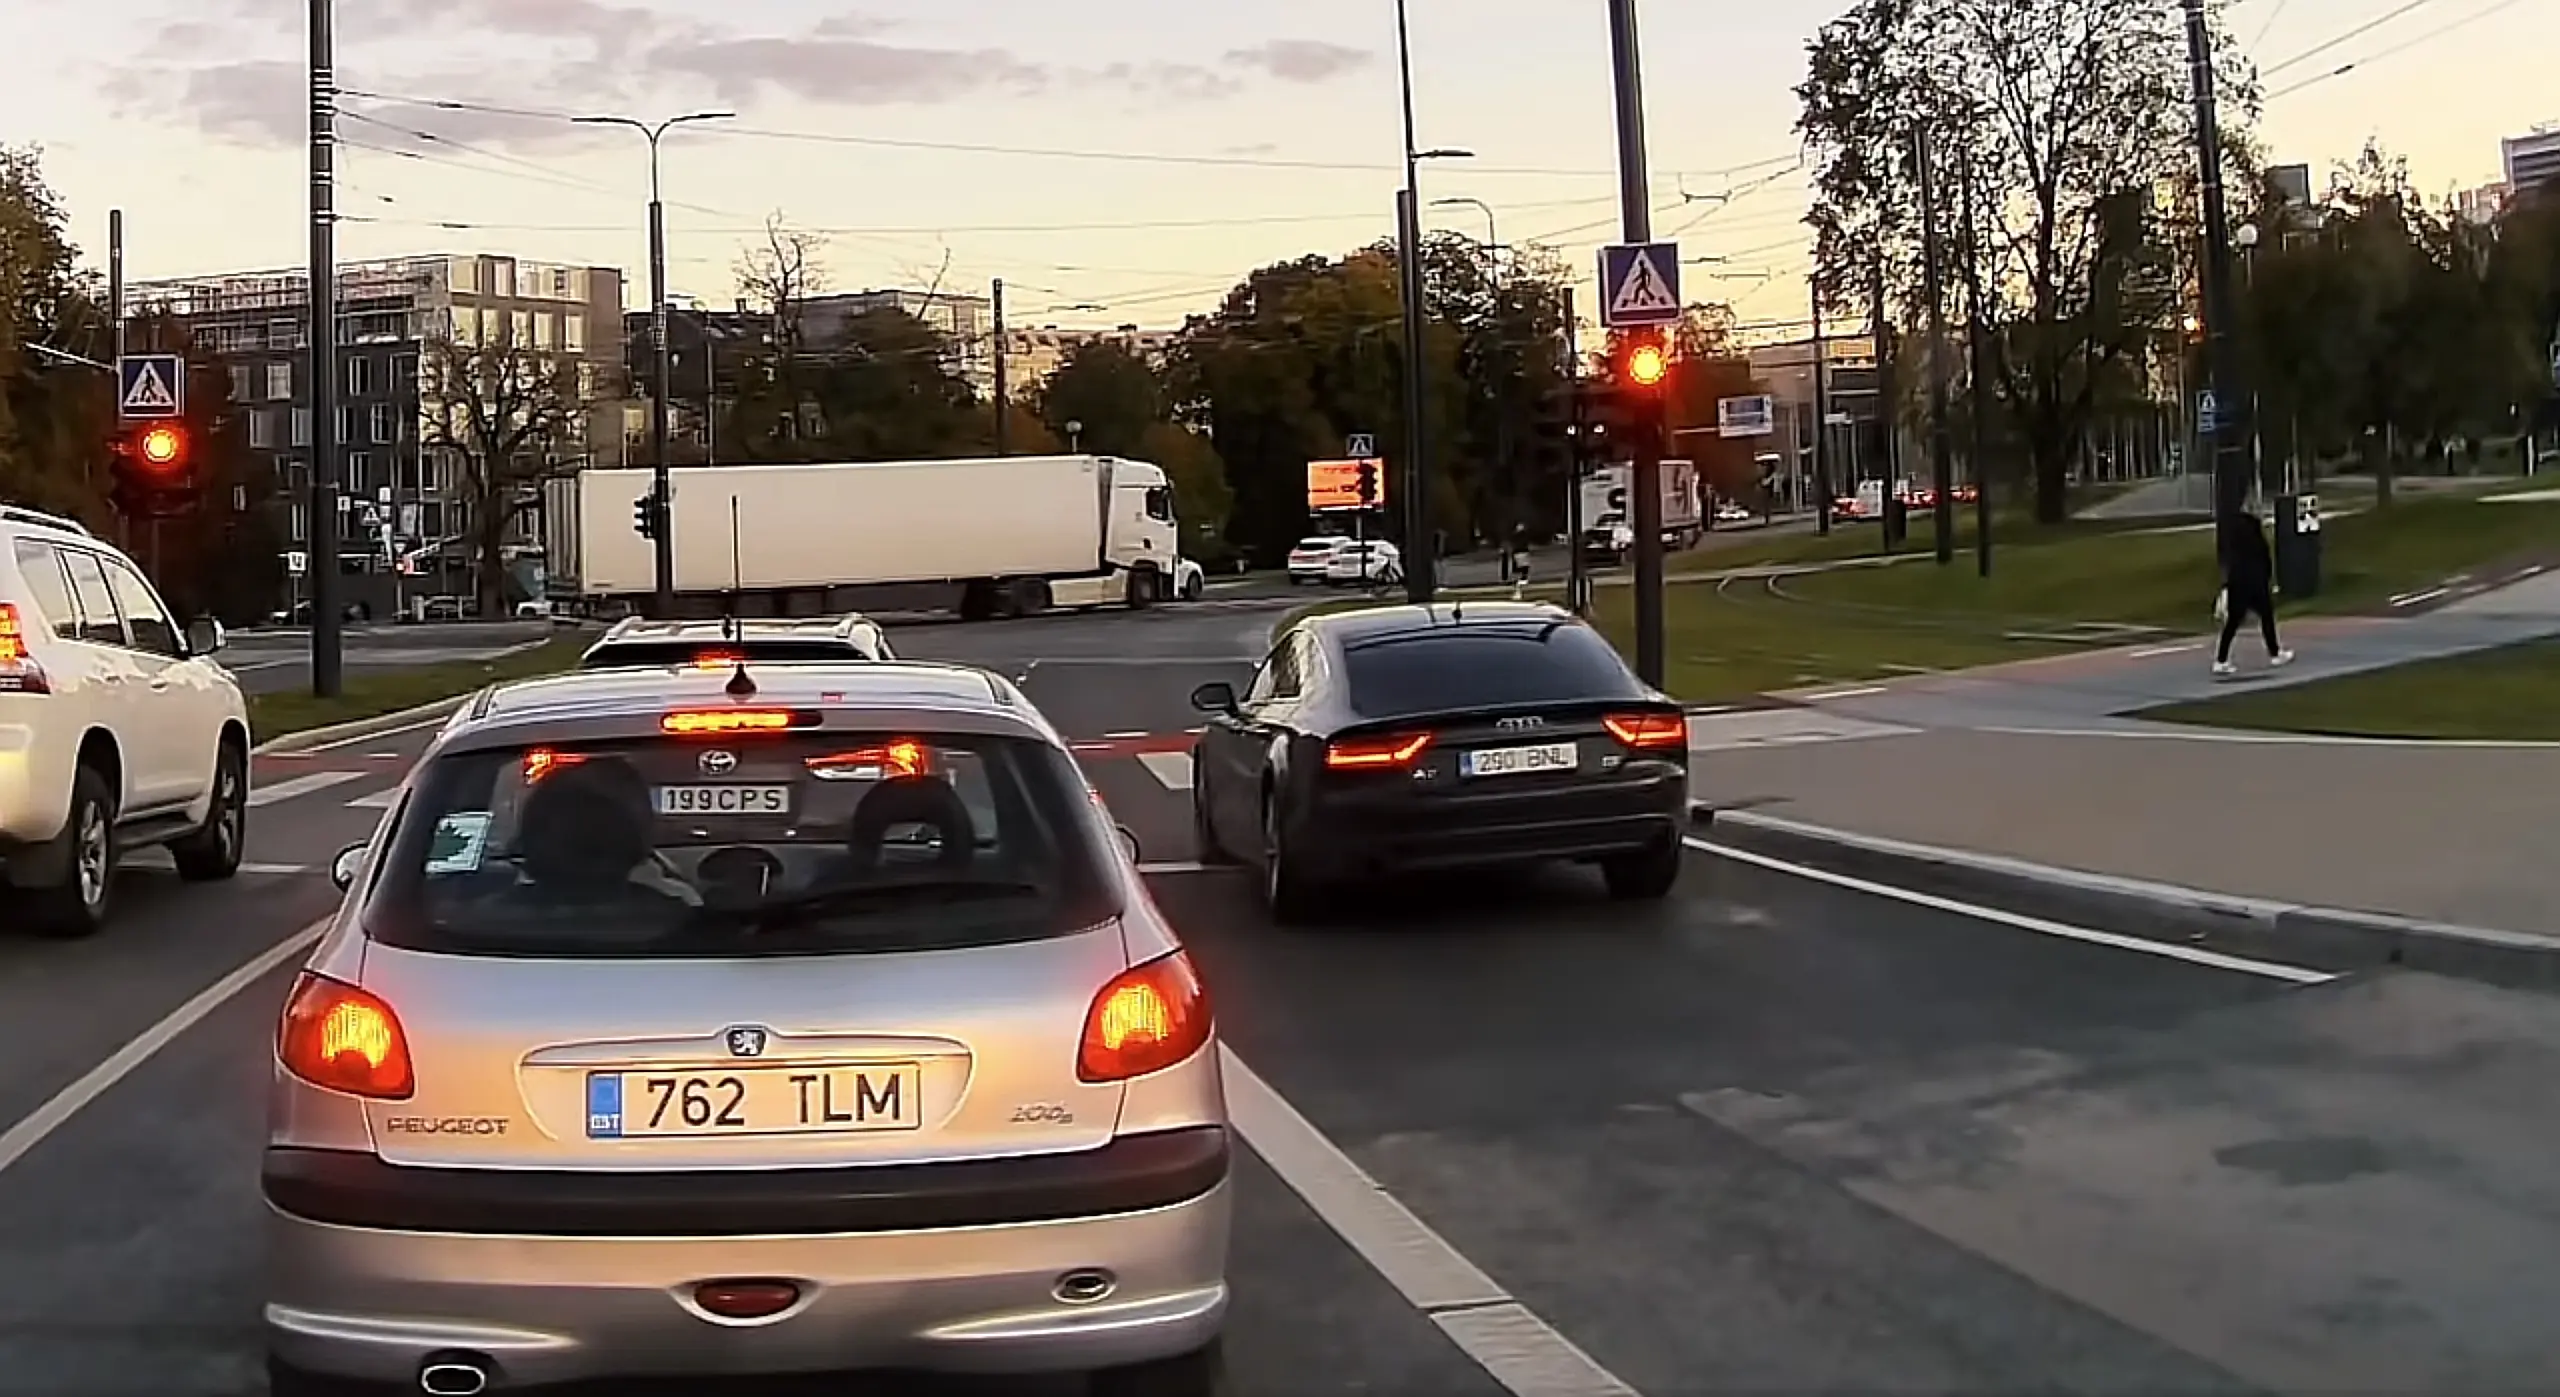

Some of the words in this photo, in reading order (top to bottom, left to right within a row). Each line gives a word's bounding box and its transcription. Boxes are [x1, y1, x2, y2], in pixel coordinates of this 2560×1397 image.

[647, 1077, 746, 1128] 762
[788, 1073, 901, 1123] TLM
[387, 1117, 510, 1135] PEUGEOT
